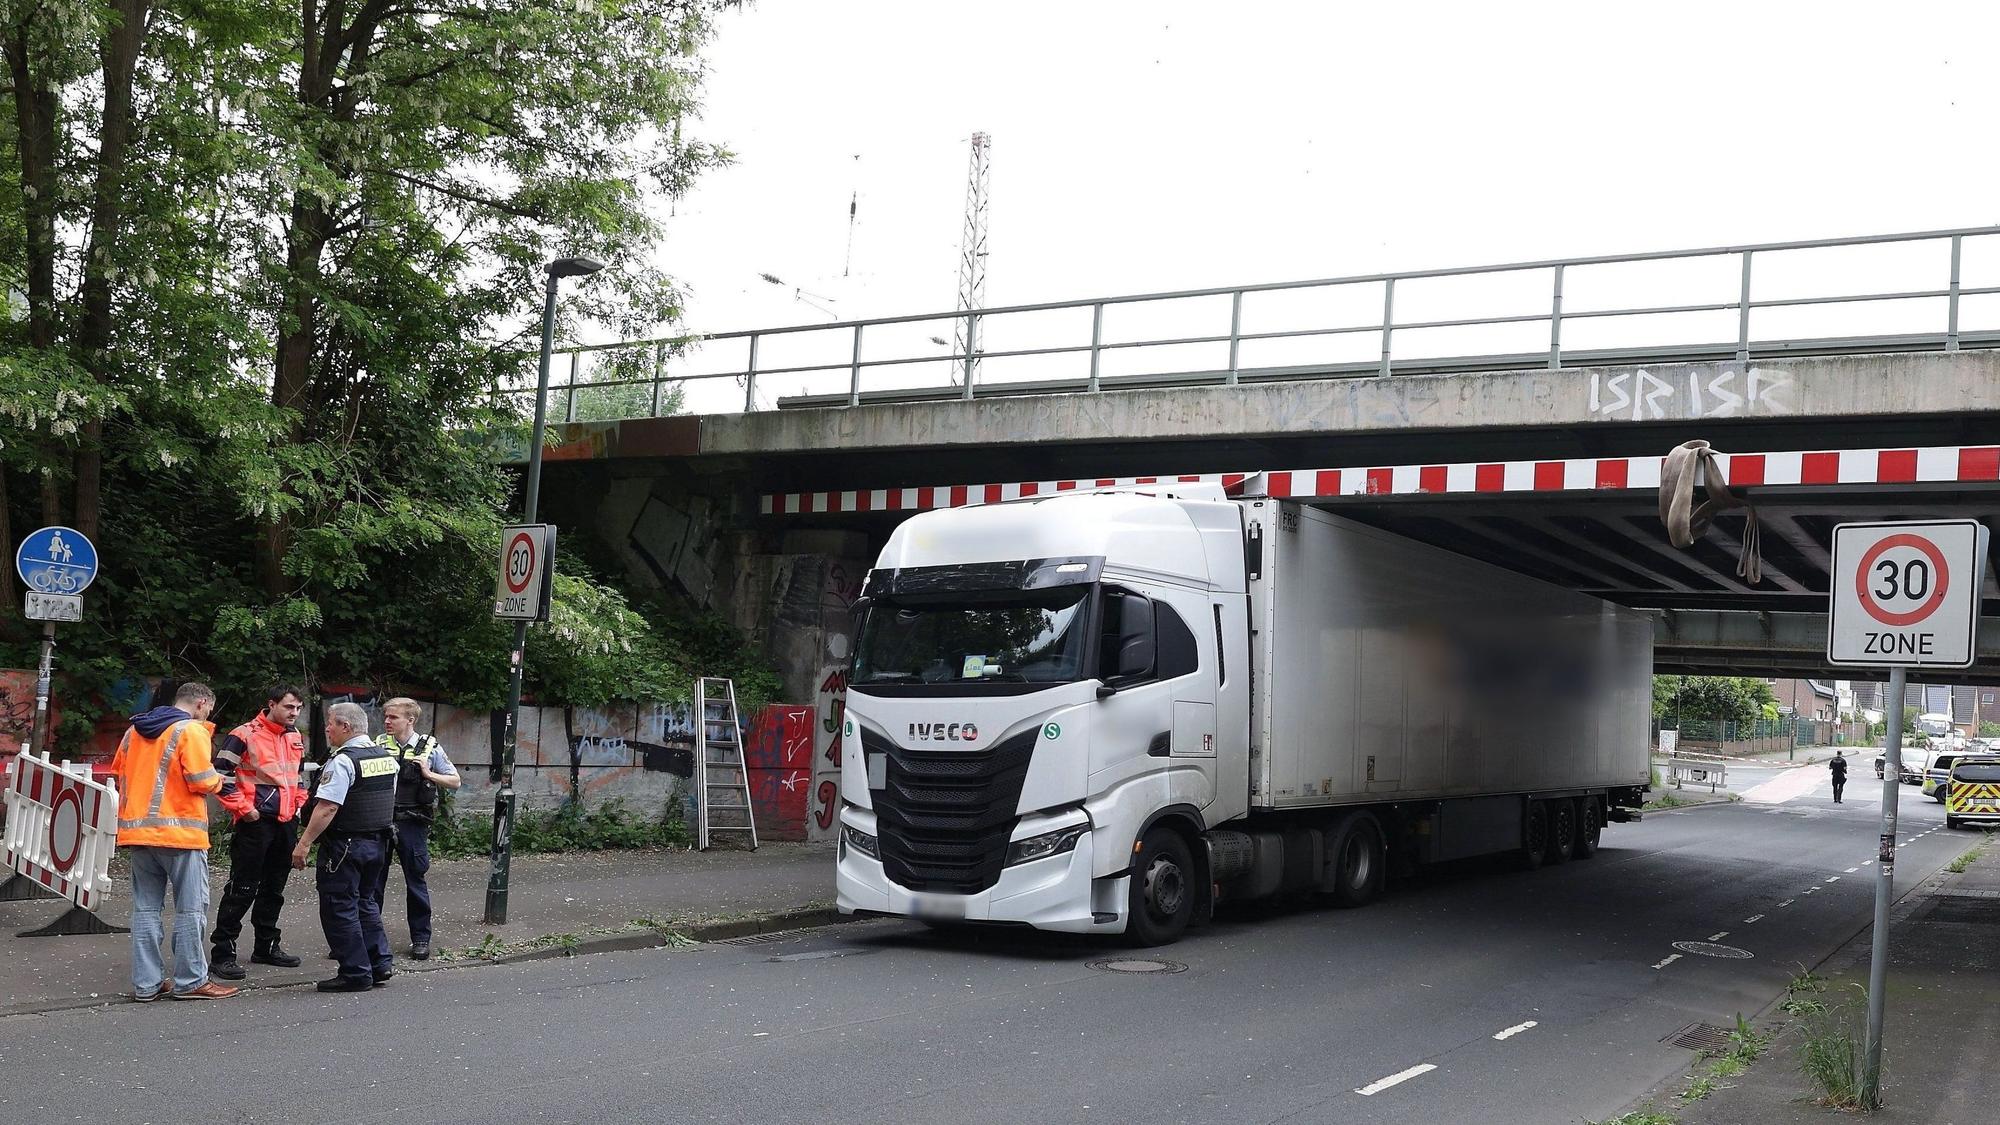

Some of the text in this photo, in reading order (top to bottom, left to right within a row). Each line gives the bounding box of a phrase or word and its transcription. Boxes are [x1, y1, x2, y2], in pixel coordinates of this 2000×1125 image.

[1590, 369, 1674, 421] ISR
[1283, 512, 1298, 527] FRC
[511, 549, 529, 576] 30
[1875, 559, 1928, 600] 30
[504, 597, 526, 612] ZONE
[1864, 632, 1934, 655] ZONE
[909, 723, 978, 741] IVECO
